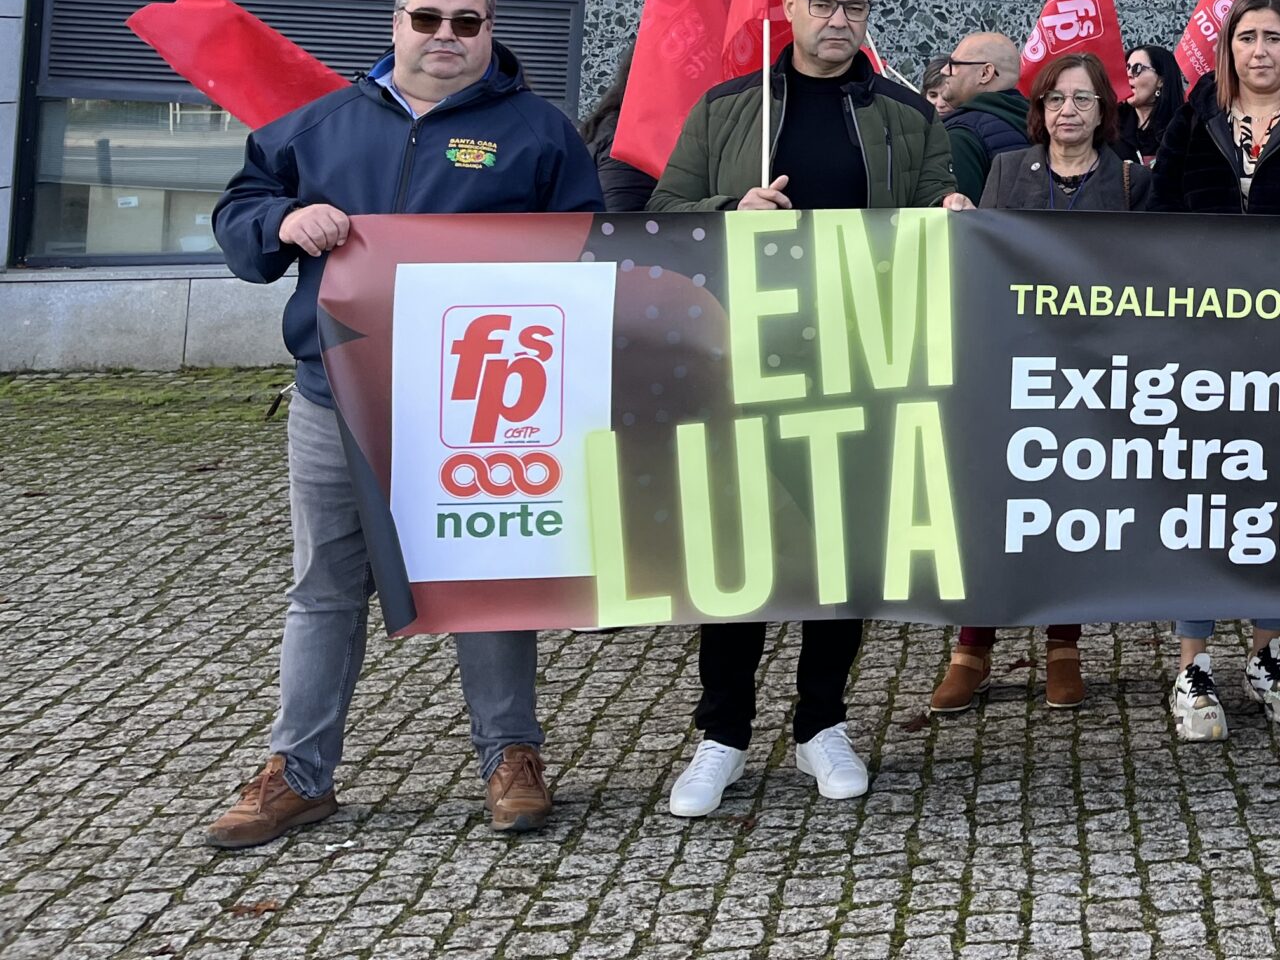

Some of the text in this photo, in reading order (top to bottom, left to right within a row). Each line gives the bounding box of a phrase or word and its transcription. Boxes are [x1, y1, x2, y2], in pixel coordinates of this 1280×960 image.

[725, 208, 954, 404] EM
[1006, 426, 1268, 482] Contra
[437, 504, 563, 538] norte
[587, 401, 966, 627] LUTA
[1004, 498, 1135, 553] Por
